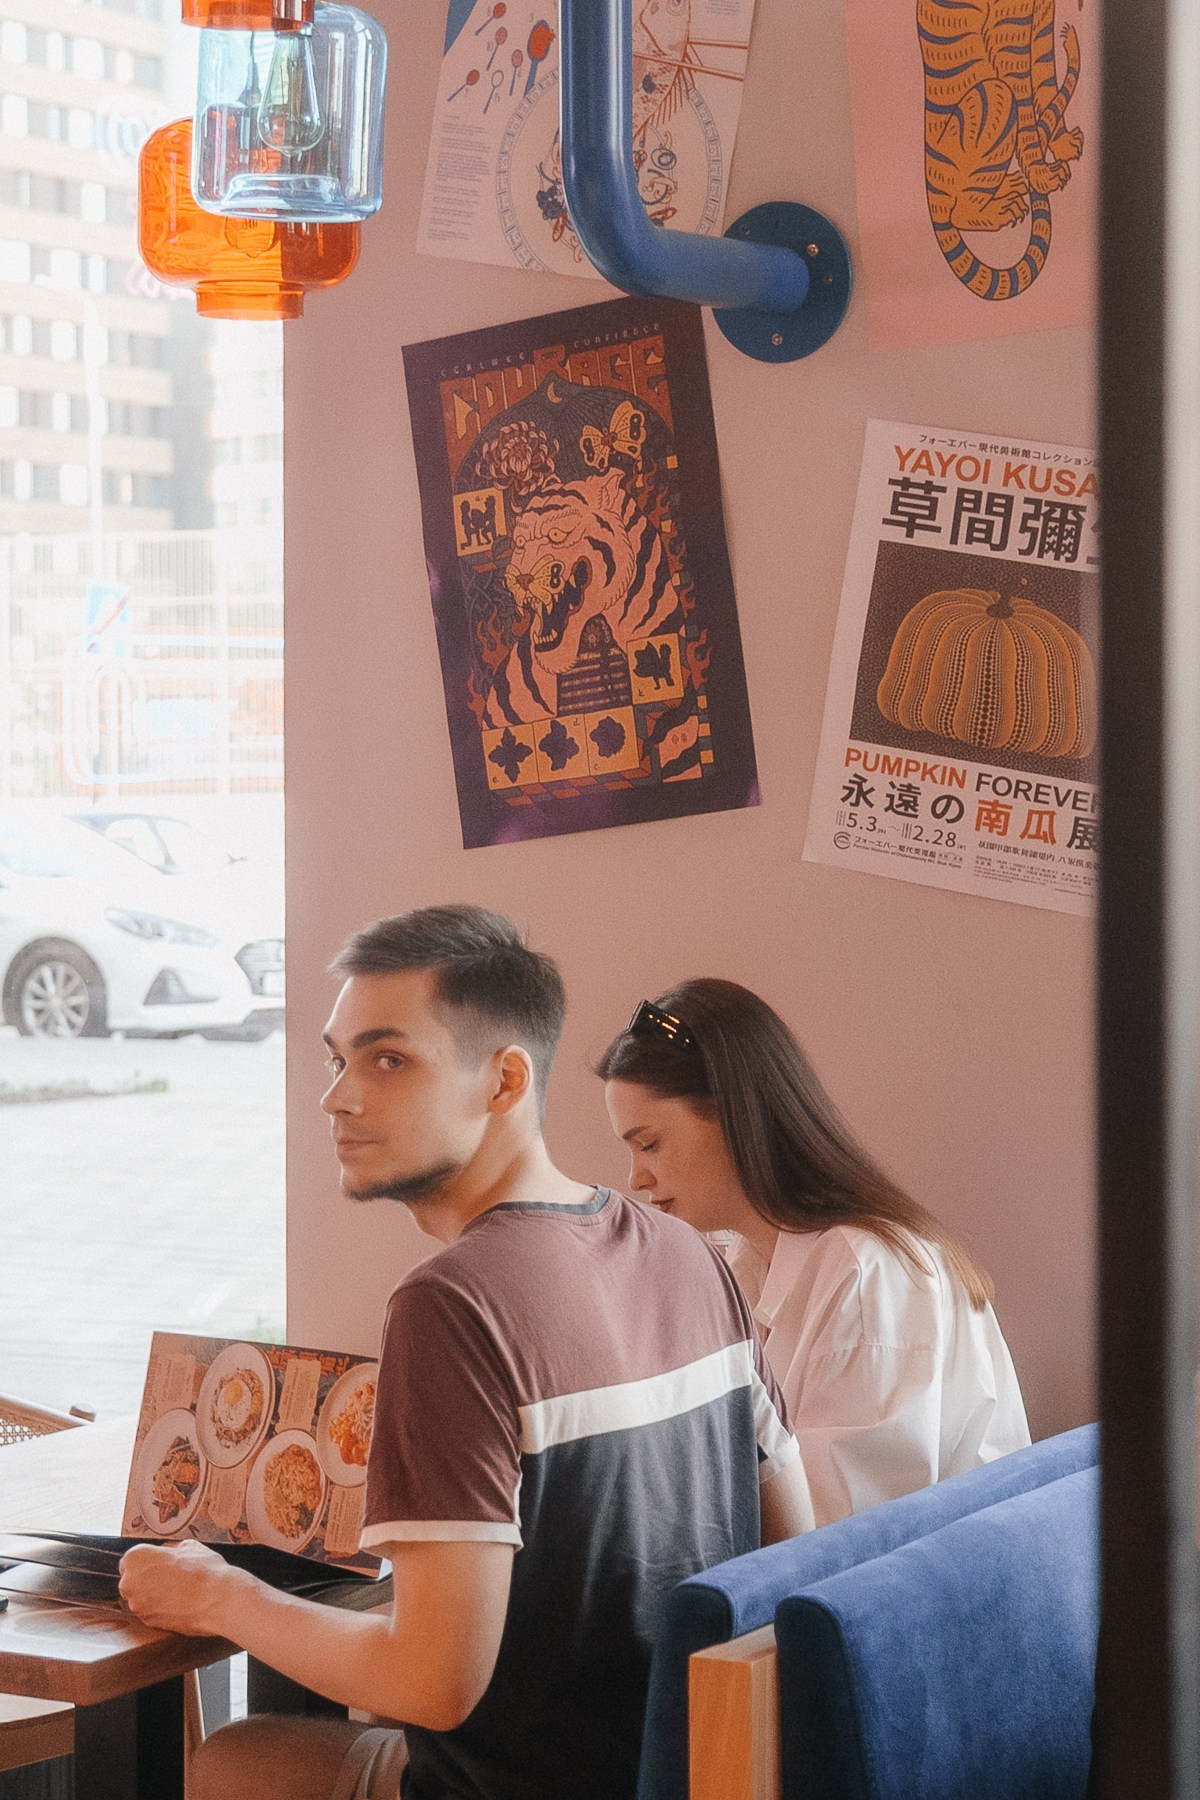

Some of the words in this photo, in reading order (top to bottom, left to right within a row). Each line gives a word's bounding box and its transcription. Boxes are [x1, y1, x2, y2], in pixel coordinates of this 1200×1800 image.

[894, 444, 991, 485] YAYOI
[882, 476, 1100, 565] 草間彌
[844, 747, 968, 789] PUMPKIN
[845, 812, 878, 832] 5.3
[913, 825, 957, 848] 2.28
